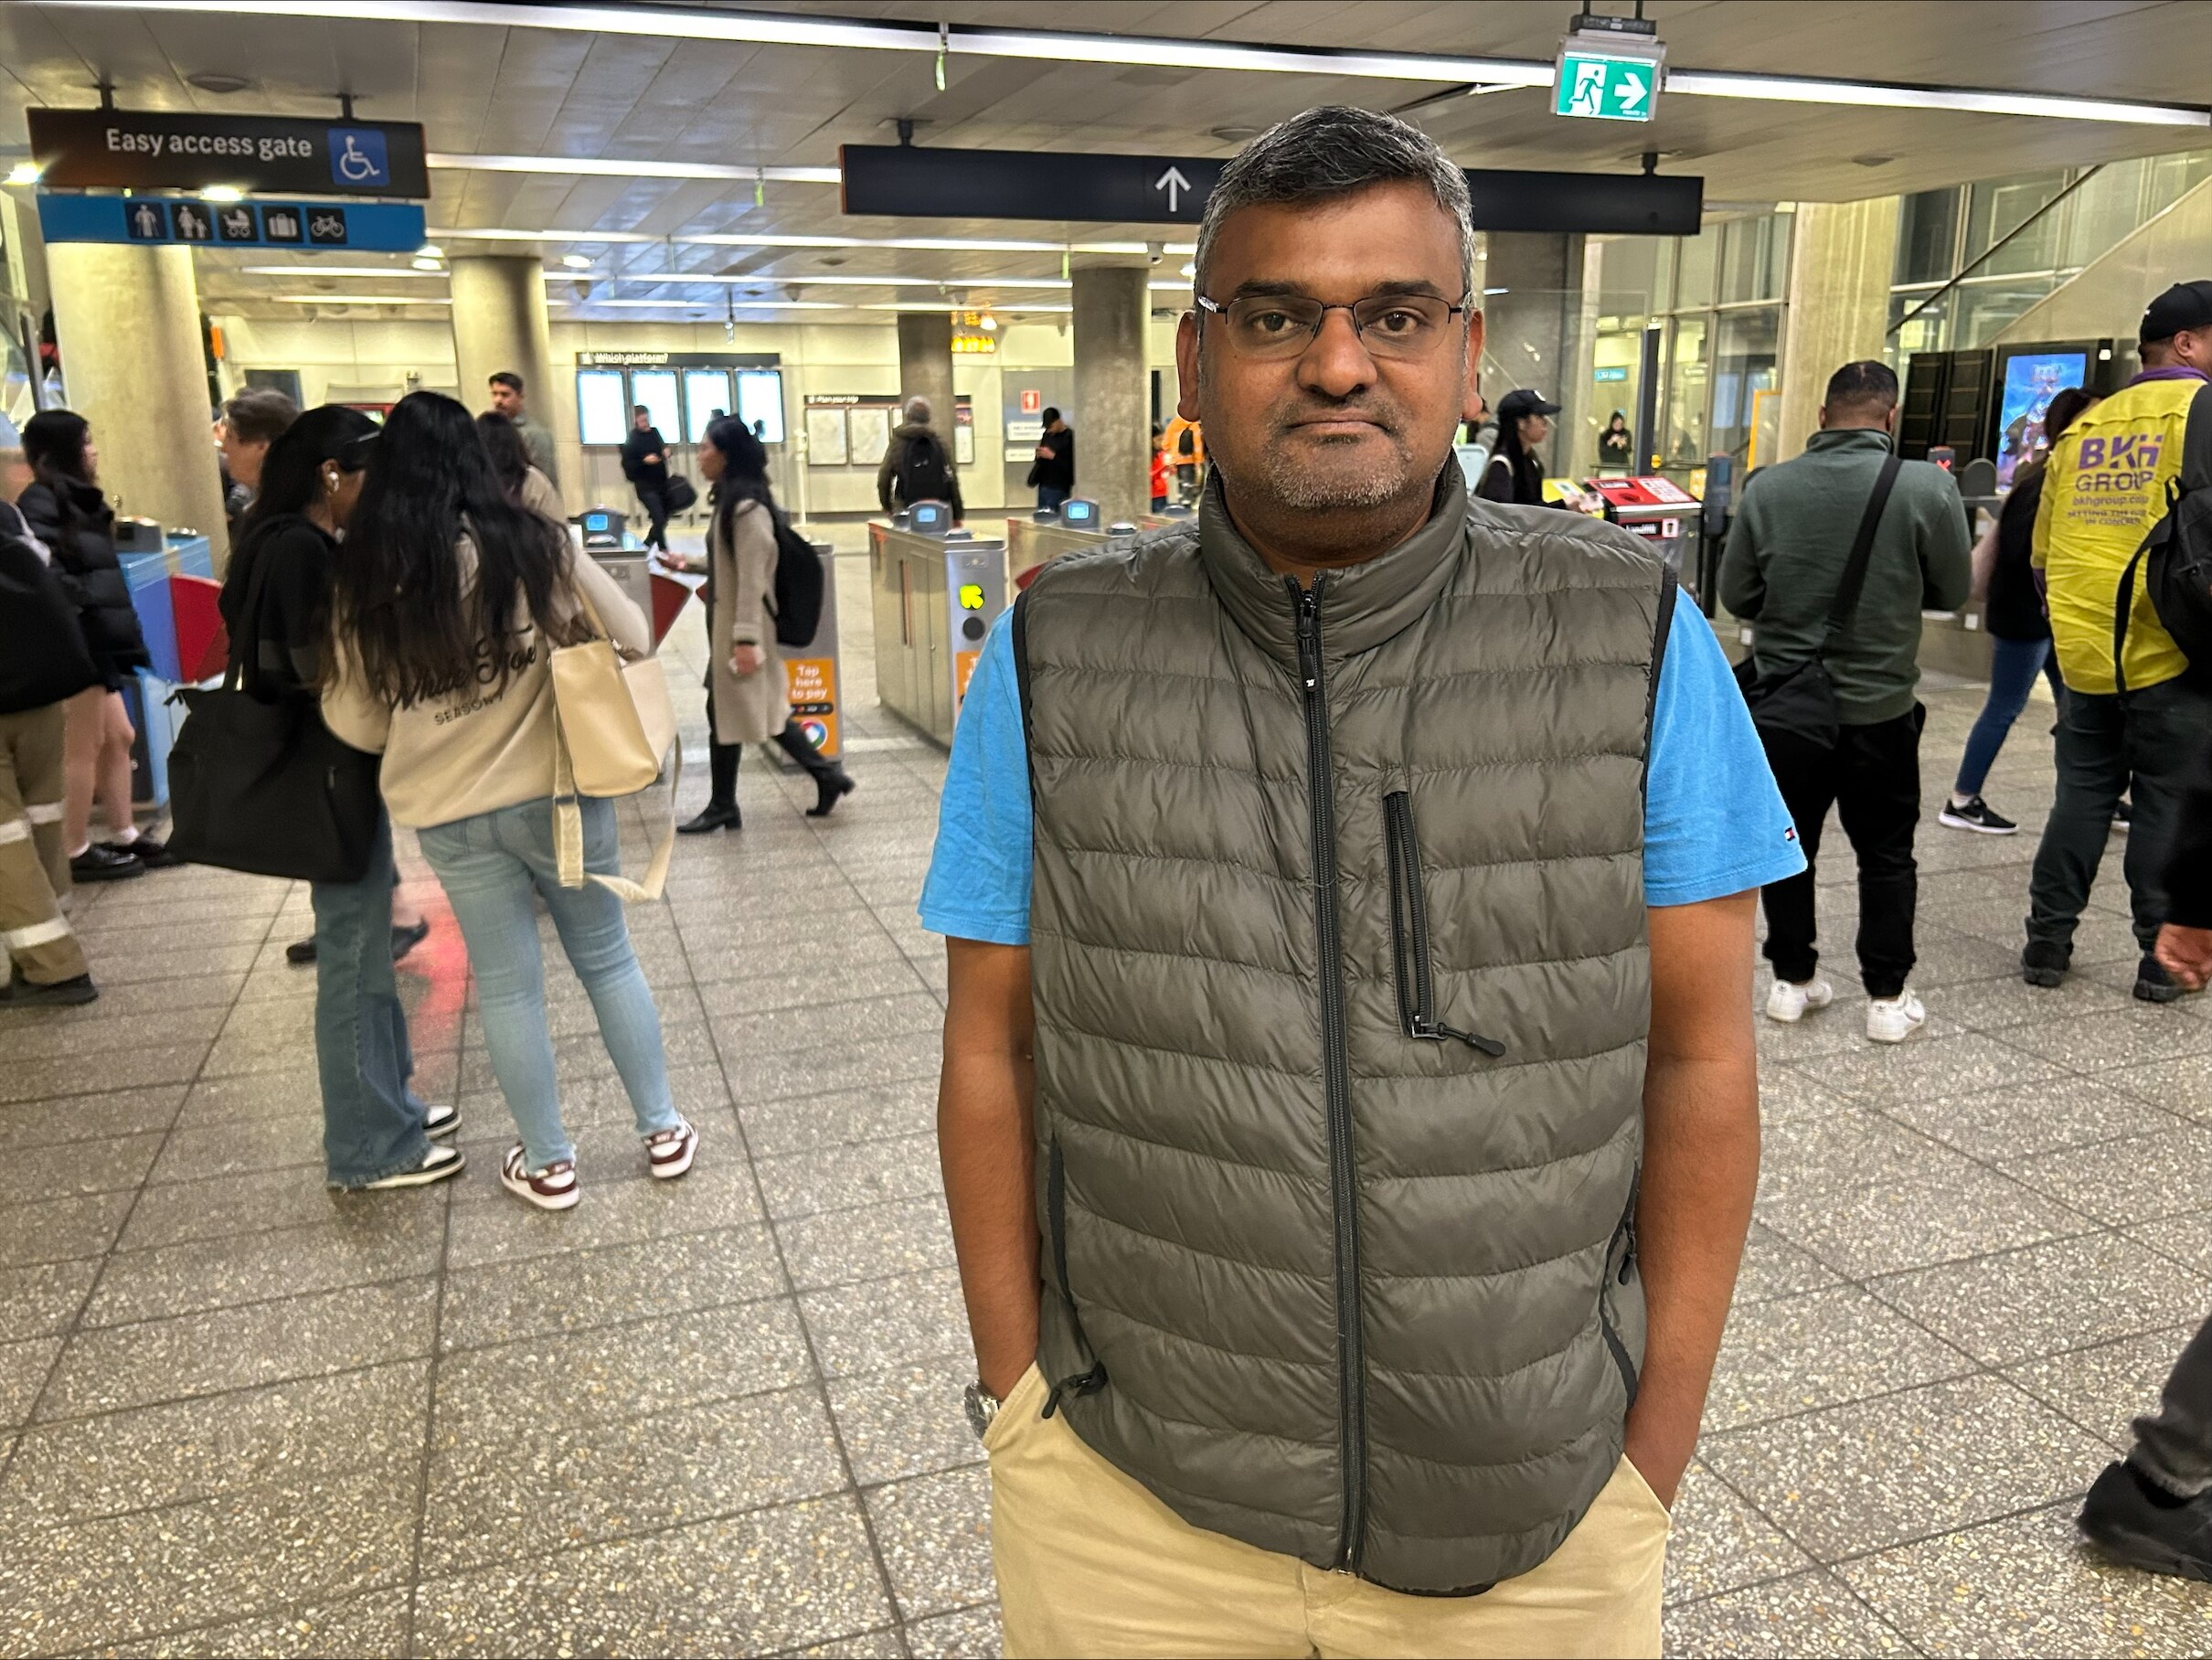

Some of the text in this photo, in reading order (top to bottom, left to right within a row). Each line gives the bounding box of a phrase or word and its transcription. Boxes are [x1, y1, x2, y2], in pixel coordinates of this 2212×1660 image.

[106, 128, 313, 162] Easy access gate
[2078, 434, 2164, 471] BKH
[796, 664, 820, 677] Tap
[795, 676, 823, 688] here
[792, 687, 828, 701] to pay
